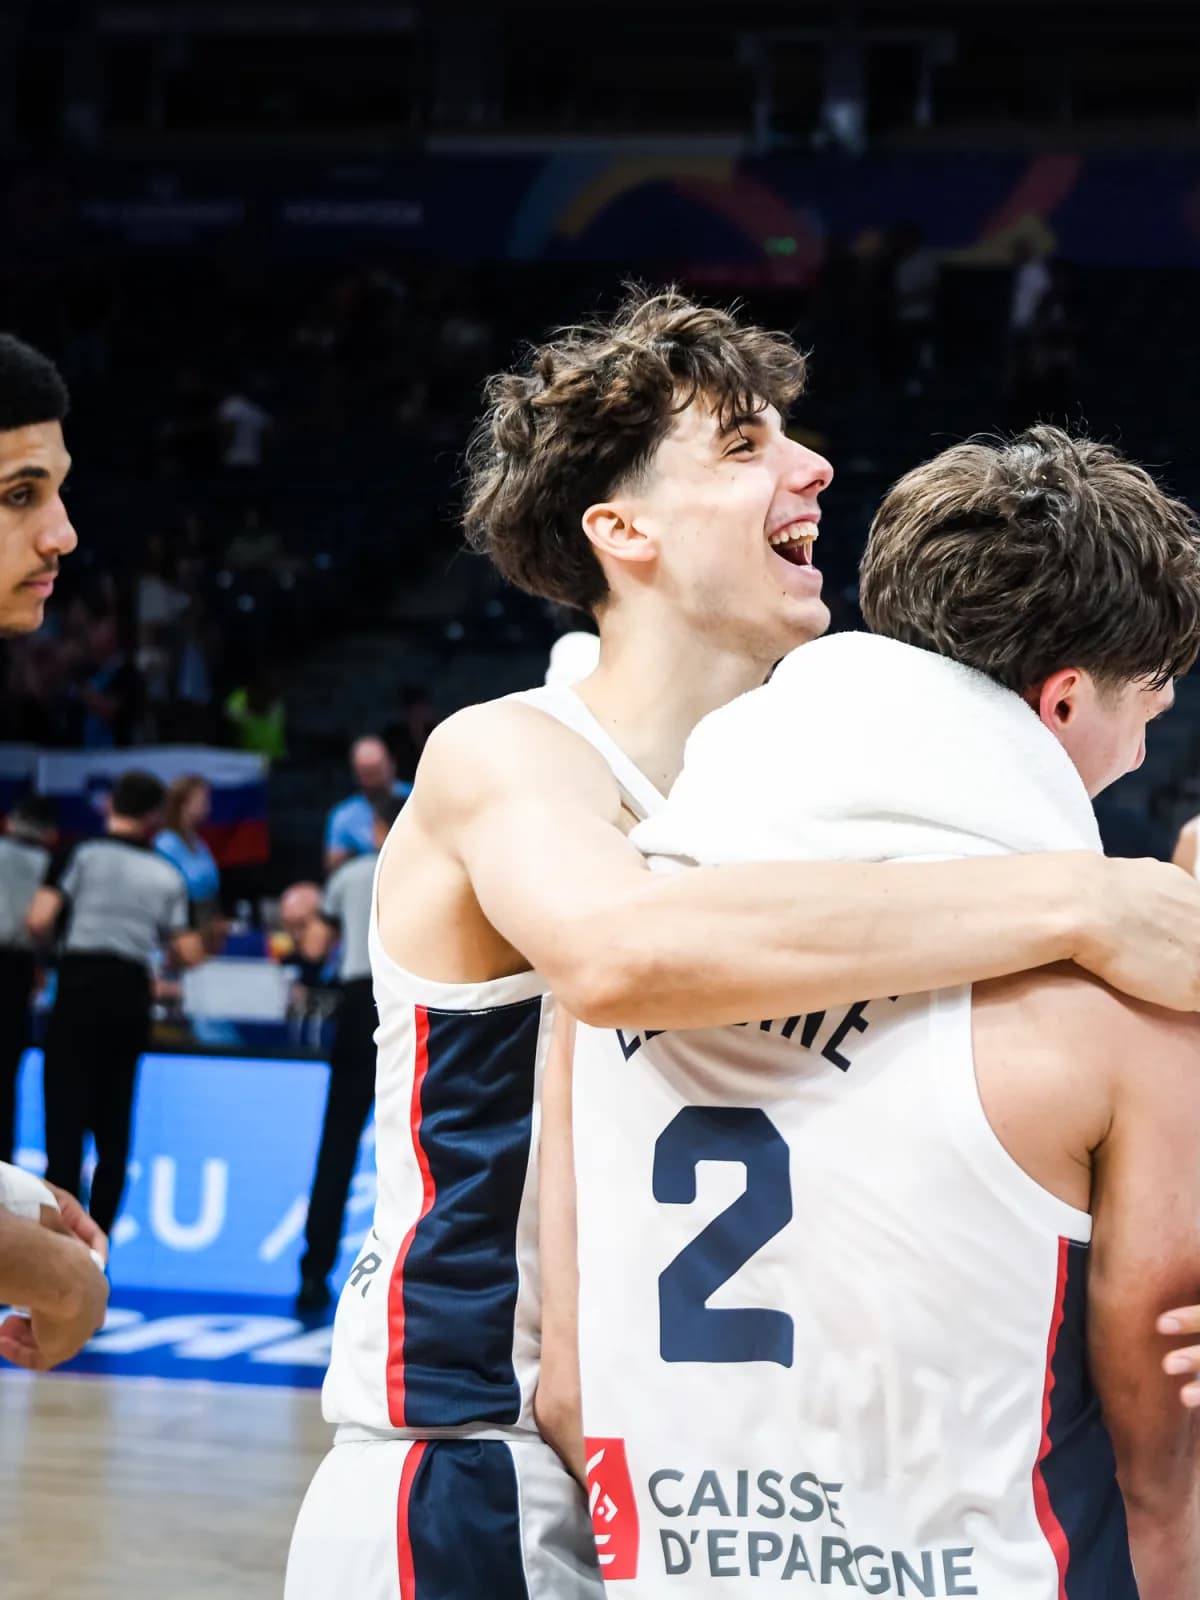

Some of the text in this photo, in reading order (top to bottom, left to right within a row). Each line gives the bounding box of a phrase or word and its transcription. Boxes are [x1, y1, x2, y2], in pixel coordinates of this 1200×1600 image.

[652, 1105, 794, 1369] 2
[648, 1468, 846, 1529] CAISSE
[659, 1528, 979, 1598] D'EPARGNE
